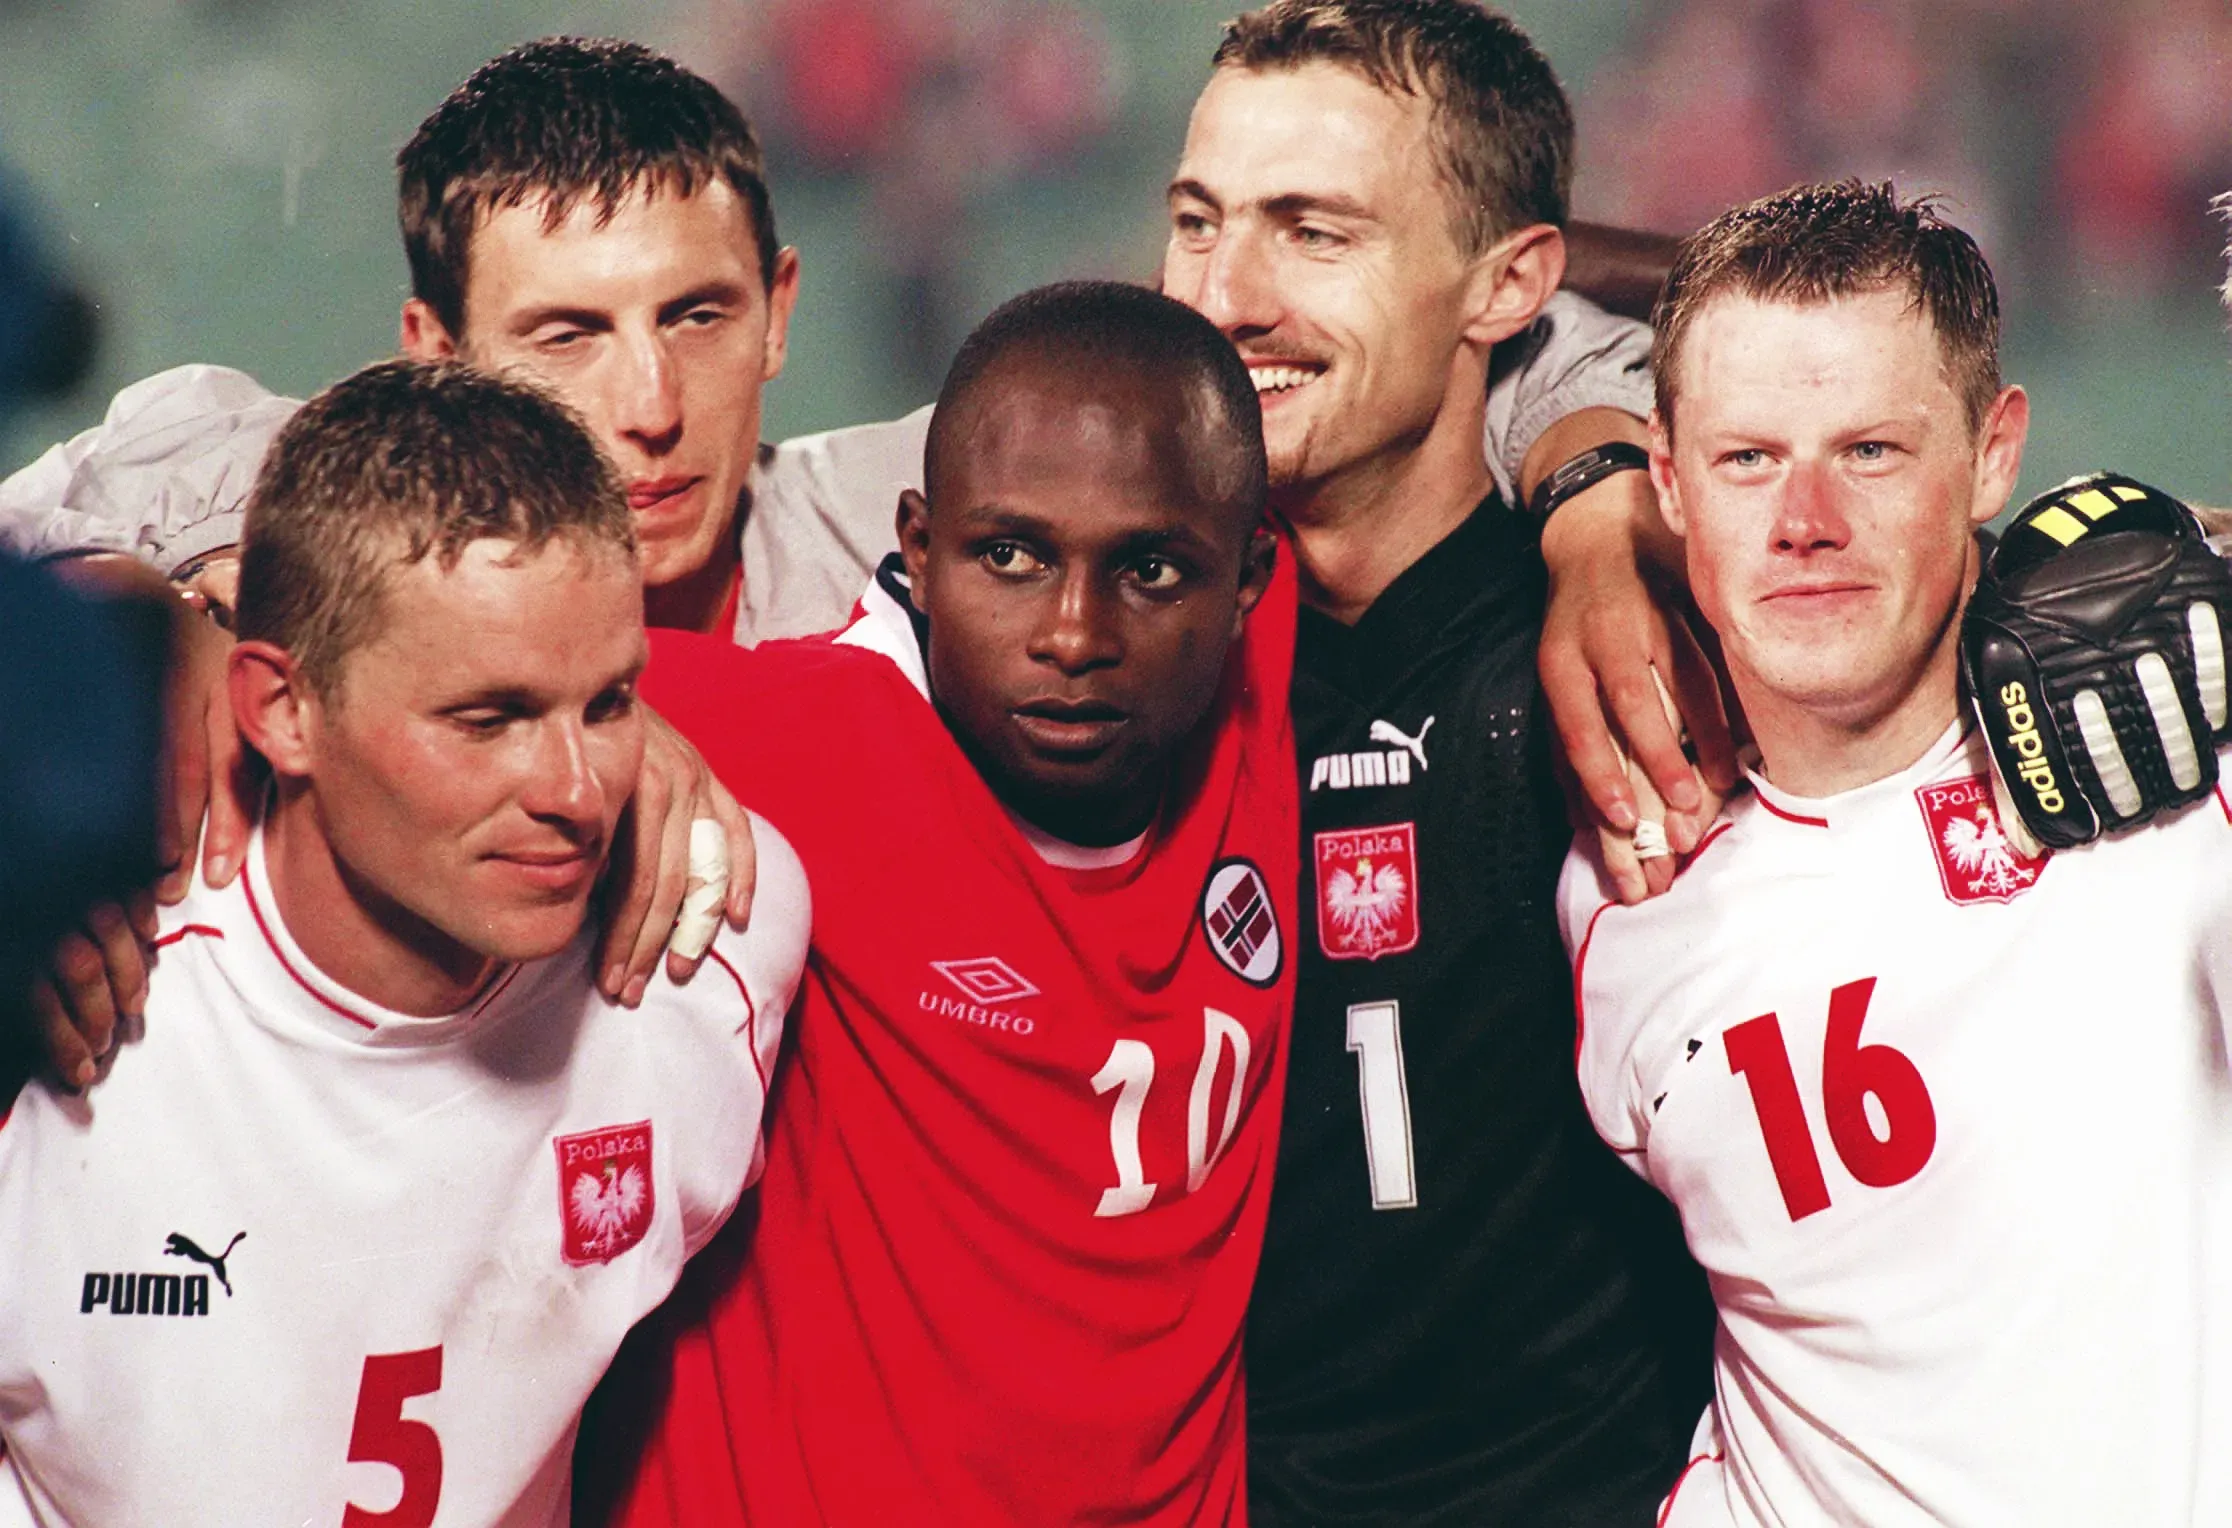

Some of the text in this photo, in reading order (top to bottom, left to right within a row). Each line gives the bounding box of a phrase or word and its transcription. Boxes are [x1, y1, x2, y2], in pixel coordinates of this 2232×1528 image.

[1310, 750, 1411, 791] PUMA
[2001, 680, 2065, 814] adidas
[1322, 832, 1404, 861] Polska
[918, 991, 1035, 1037] UMBRO
[1090, 1007, 1251, 1217] 10
[1346, 999, 1418, 1210] 1
[1722, 976, 1937, 1222] 16
[565, 1134, 645, 1167] Polska
[80, 1272, 209, 1316] PUMA
[341, 1344, 444, 1528] 5
